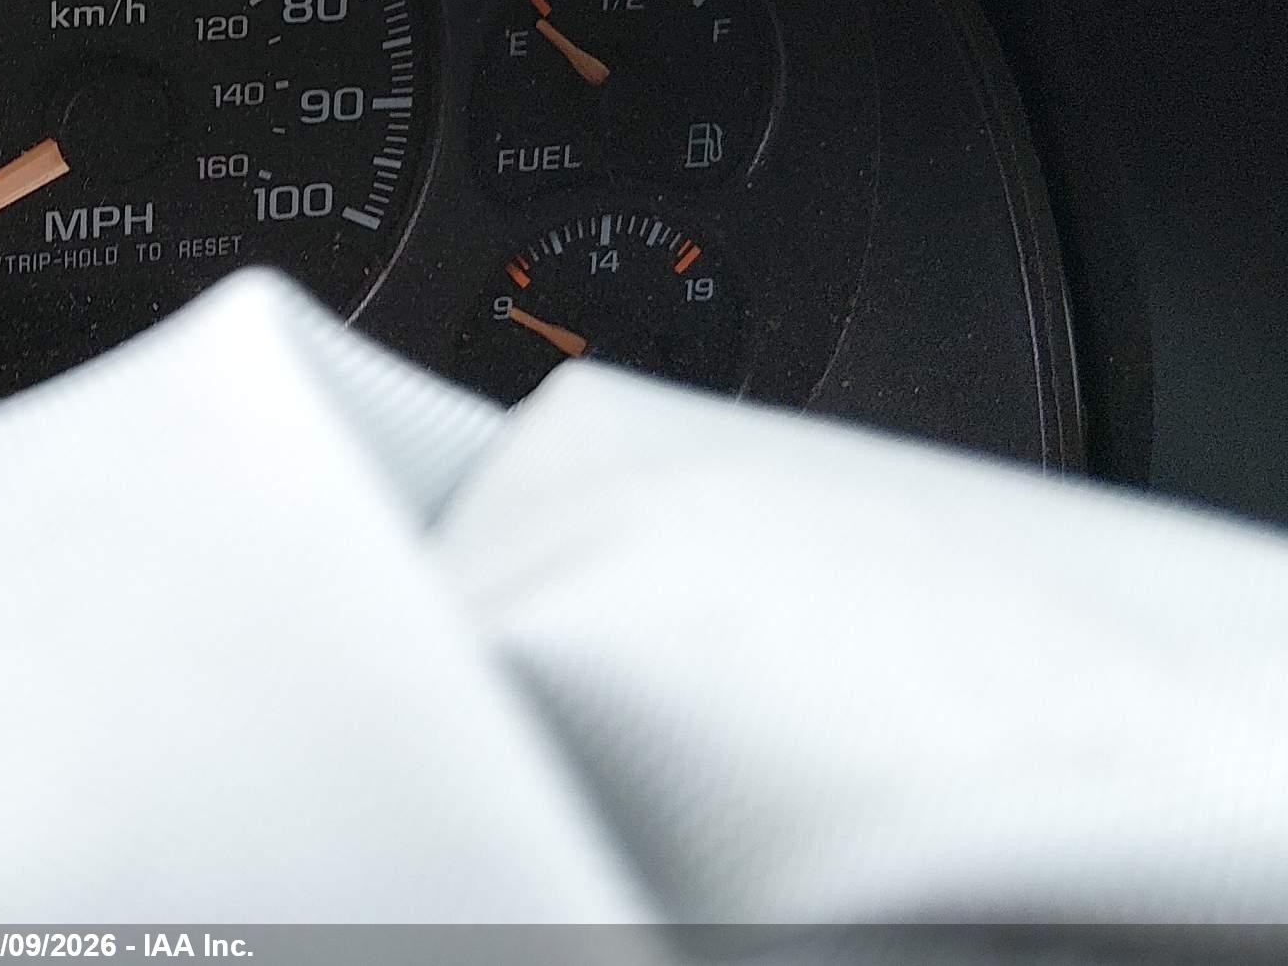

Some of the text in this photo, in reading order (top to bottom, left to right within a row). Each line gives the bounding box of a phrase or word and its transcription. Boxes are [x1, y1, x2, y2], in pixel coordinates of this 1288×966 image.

[194, 14, 248, 42] 120
[712, 18, 732, 43] F
[509, 31, 529, 57] E
[212, 81, 264, 108] 140
[300, 86, 364, 124] 90
[196, 153, 249, 181] 160
[497, 144, 583, 175] FUEL
[252, 182, 334, 222] 100
[45, 202, 153, 243] MPH
[136, 241, 162, 263] TO
[178, 235, 242, 259] RESET
[587, 249, 620, 275] 14
[684, 278, 715, 303] 19
[493, 296, 513, 321] 9
